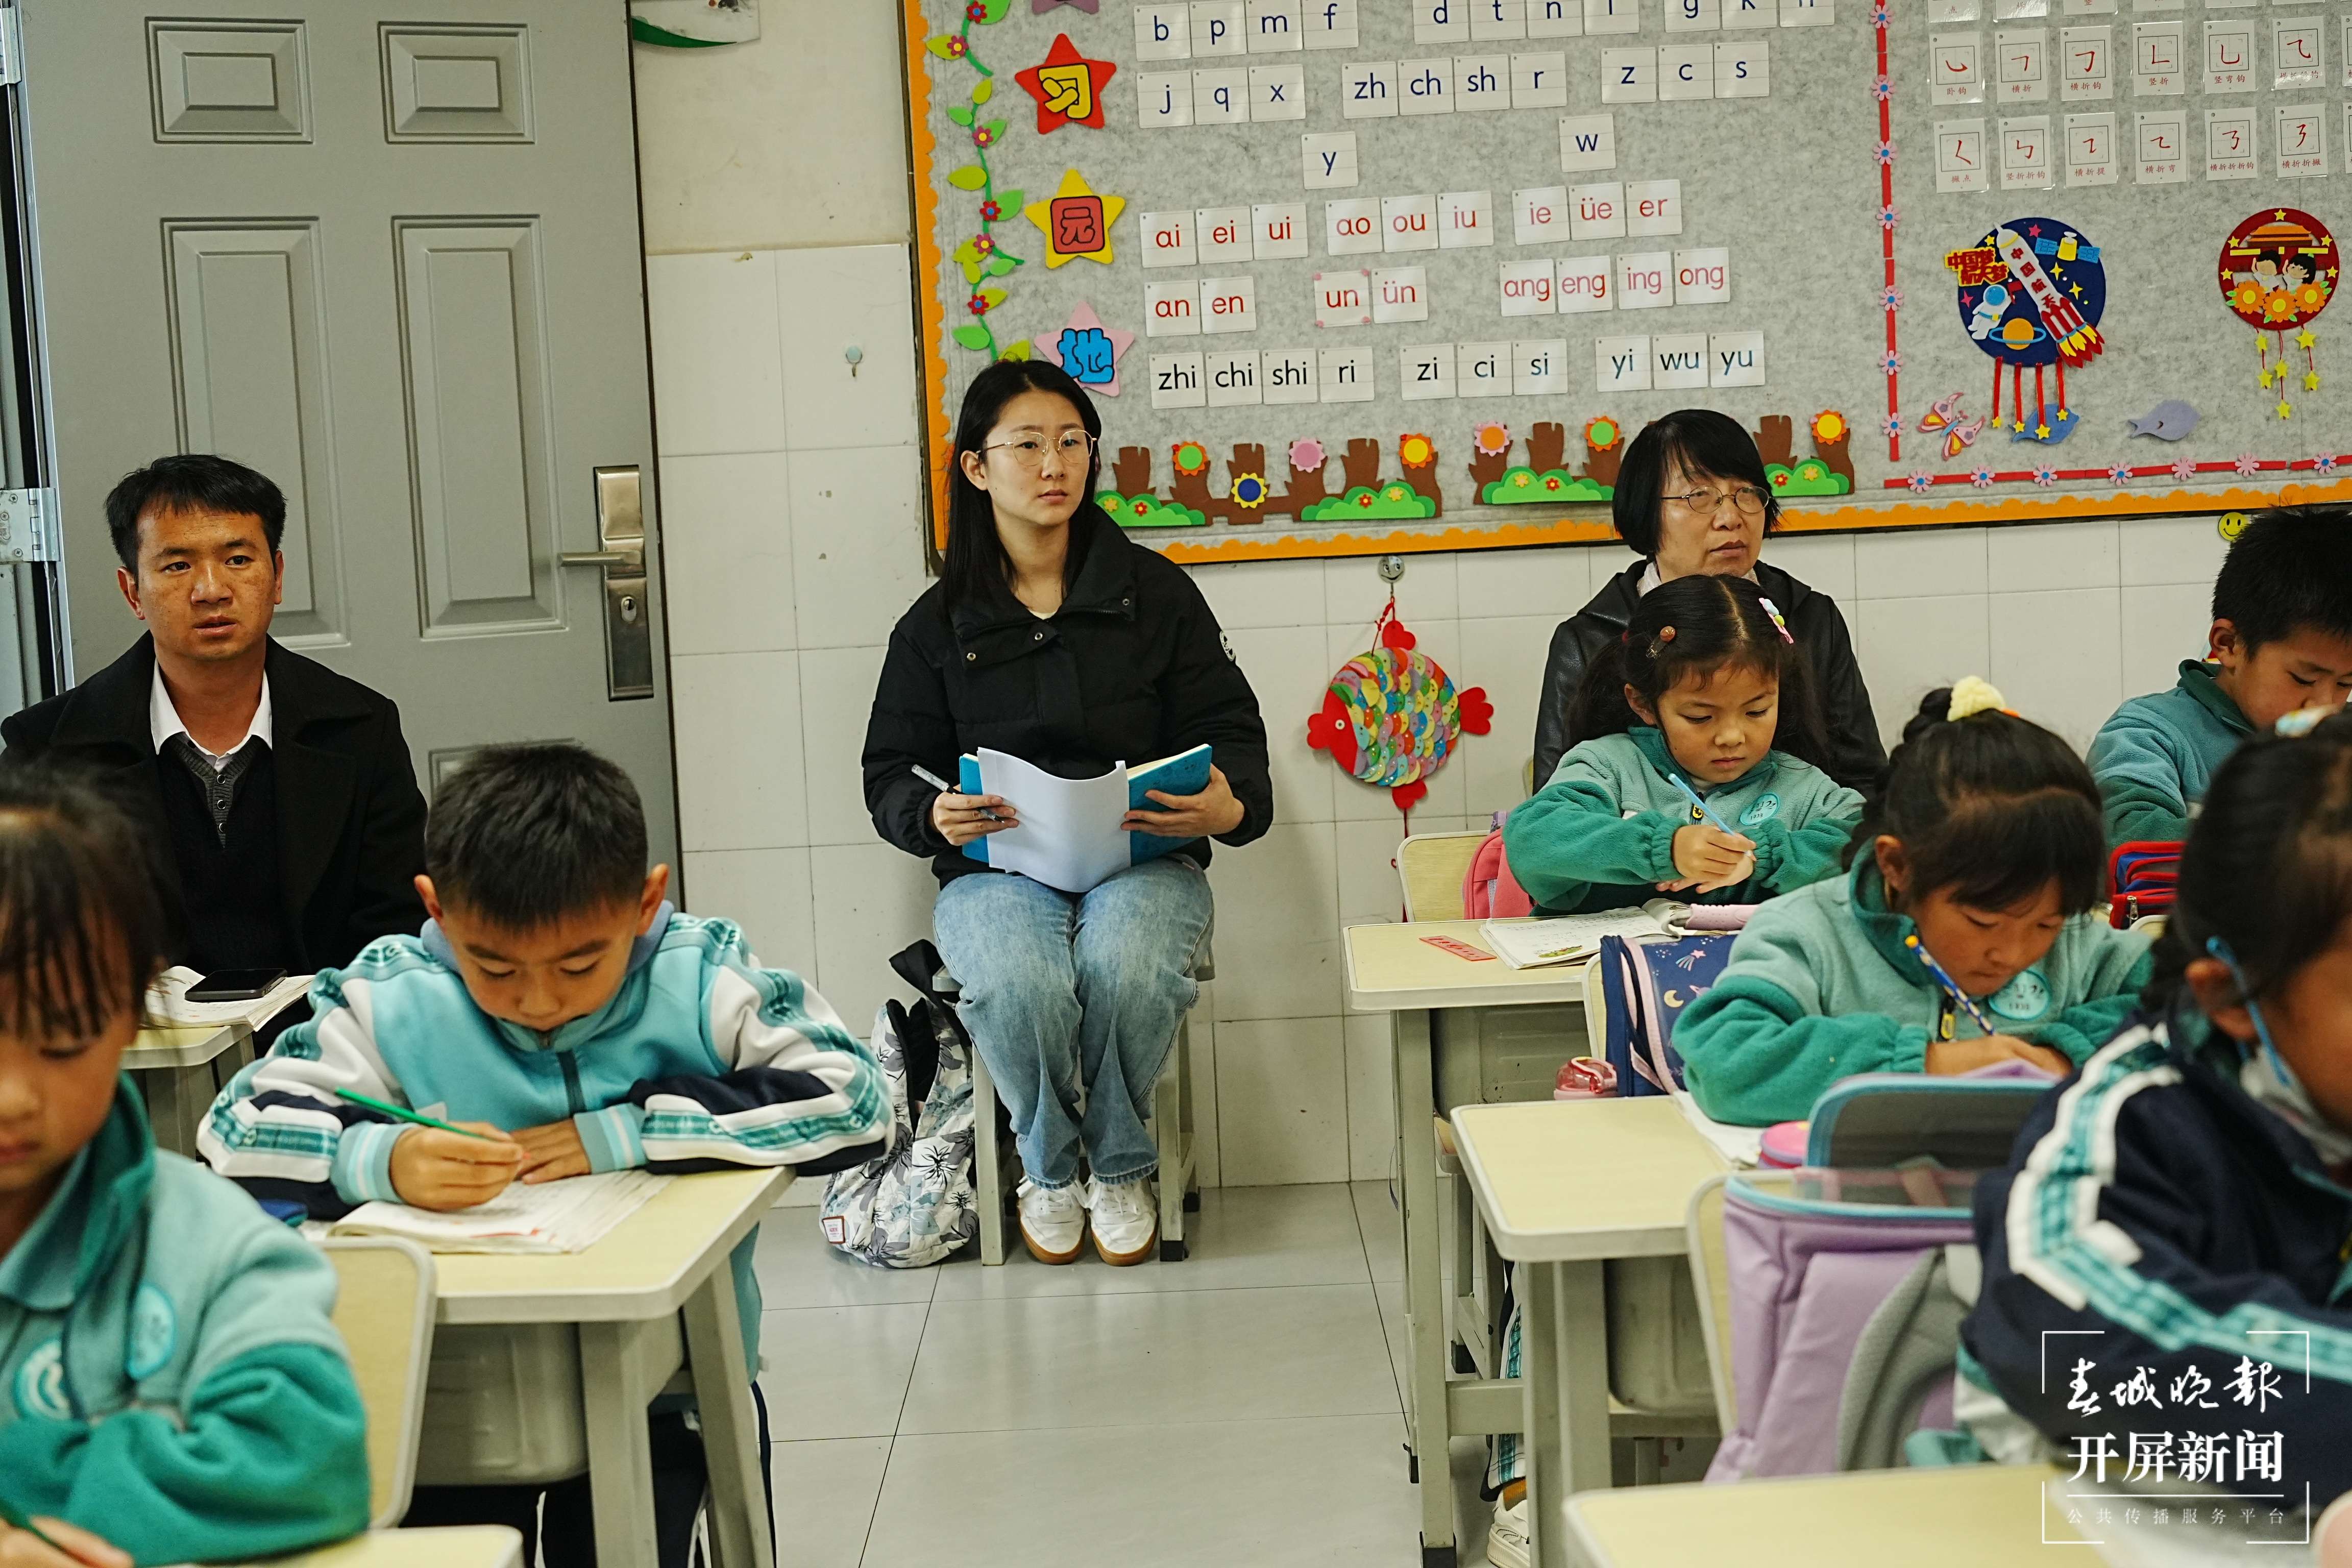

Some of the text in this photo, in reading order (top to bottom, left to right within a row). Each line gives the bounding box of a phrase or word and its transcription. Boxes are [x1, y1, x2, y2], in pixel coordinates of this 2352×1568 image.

[1154, 15, 1169, 41] b
[1211, 20, 1225, 45] p
[1261, 15, 1287, 34] m
[1324, 3, 1338, 30] f
[1433, 0, 1448, 24] d
[1492, 0, 1503, 21] t
[1547, 2, 1561, 19] n
[1159, 61, 1747, 114] j q x zh ch sh r z c s
[2012, 85, 2032, 94] 横折
[2070, 82, 2101, 92] 横折钩
[2149, 77, 2168, 86] 竖折
[2214, 75, 2245, 85] 竖弯钩
[1322, 134, 1598, 176] y w
[2209, 162, 2254, 172] 横折折折钩
[1156, 198, 1668, 248] ai ei ui ao ou iu ie üe er
[1156, 266, 1724, 317] an en un ün ang eng ing ong
[1057, 328, 1114, 383] 地
[1159, 349, 1752, 390] zhi chi shi ri zi ci si yi wu yu
